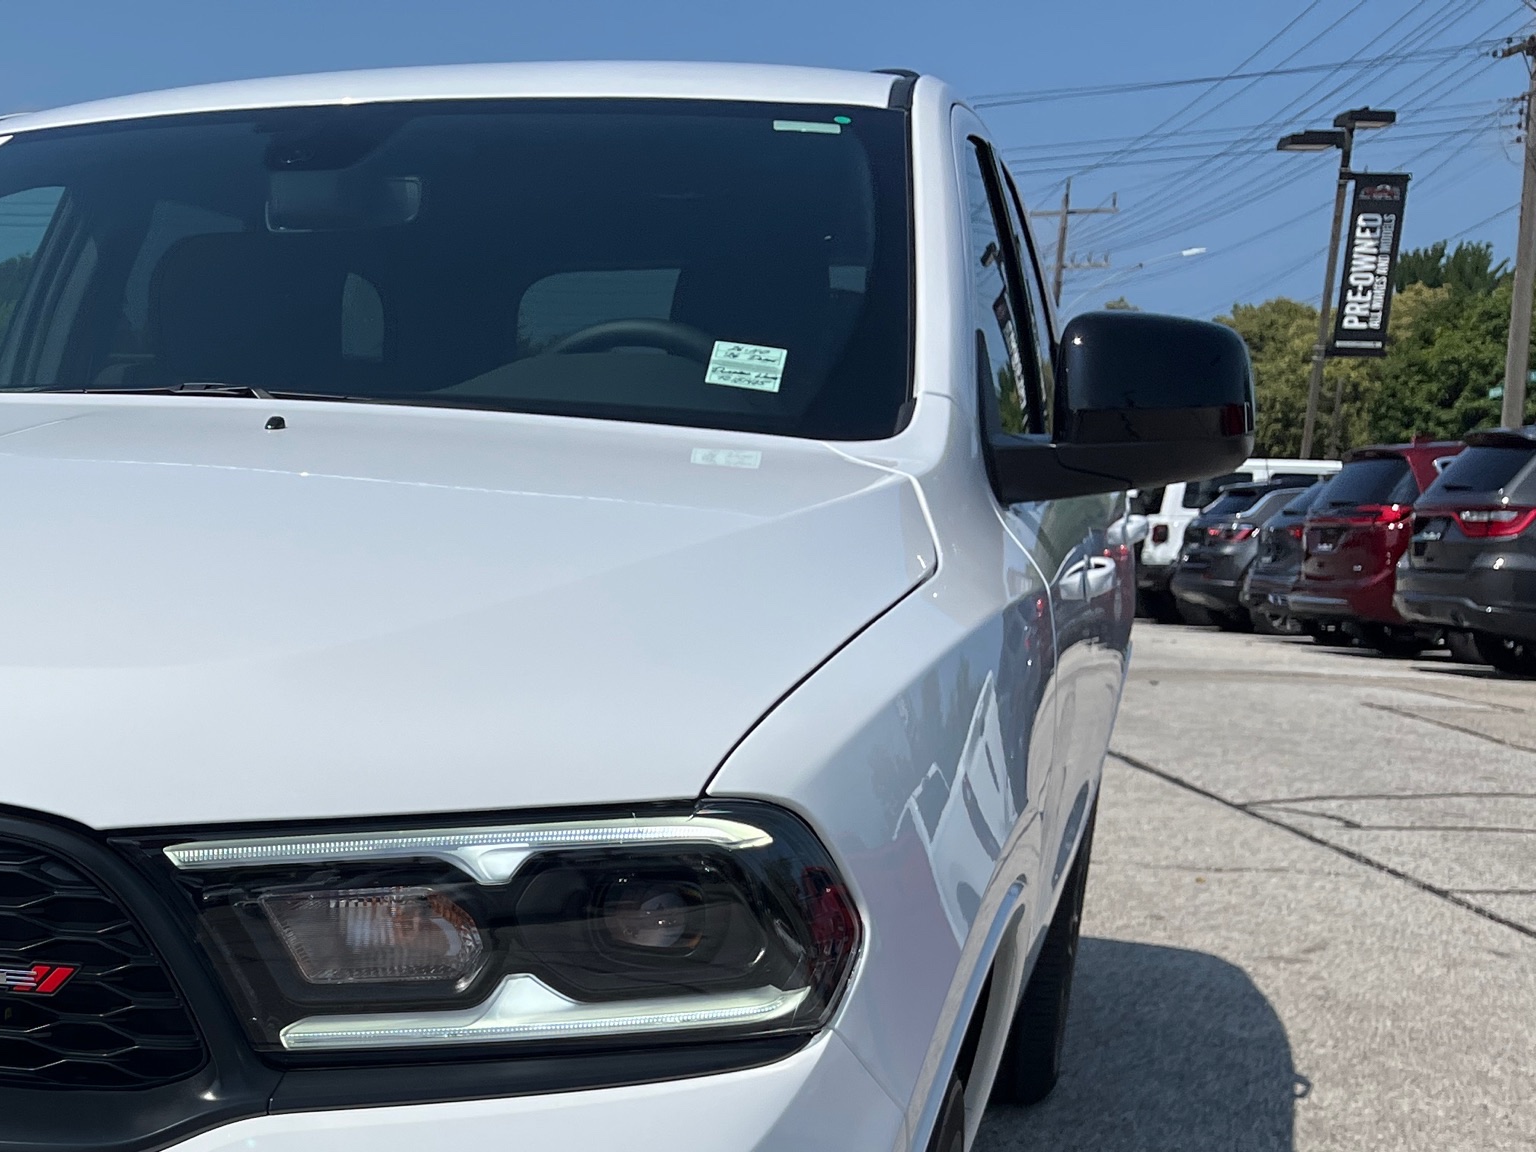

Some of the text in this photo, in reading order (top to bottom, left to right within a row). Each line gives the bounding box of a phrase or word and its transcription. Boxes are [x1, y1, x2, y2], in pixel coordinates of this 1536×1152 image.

[1341, 212, 1383, 331] PRE-OWNED
[1369, 213, 1396, 330] ALL MAKES AND MODELS
